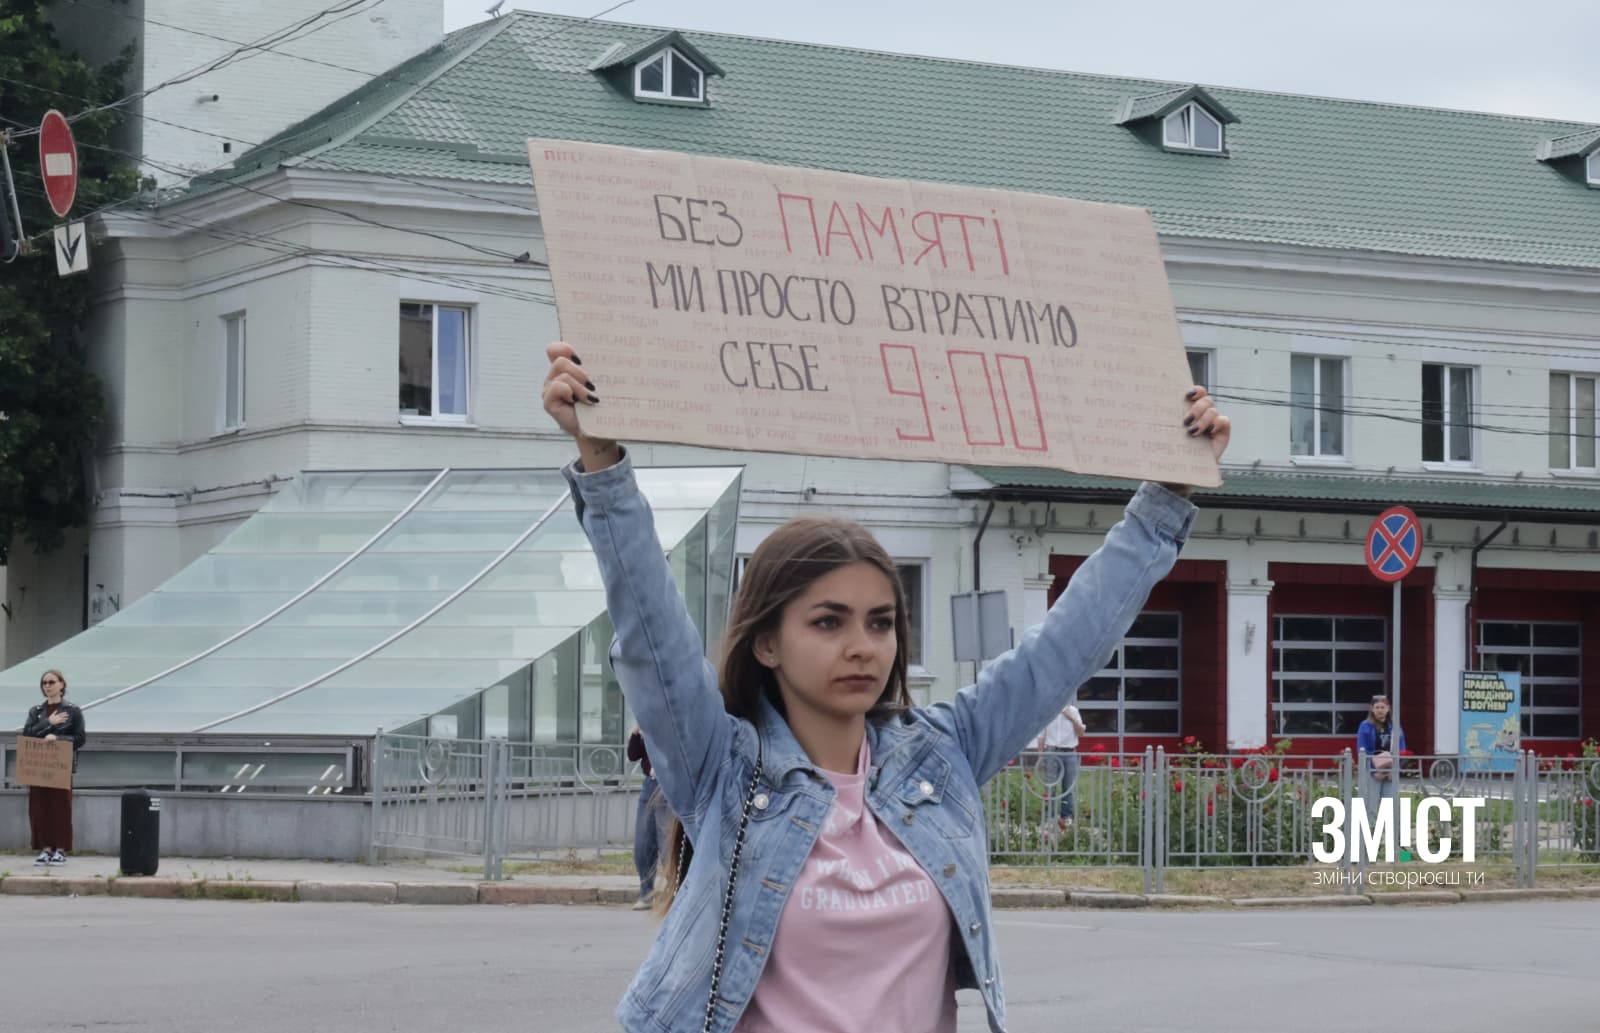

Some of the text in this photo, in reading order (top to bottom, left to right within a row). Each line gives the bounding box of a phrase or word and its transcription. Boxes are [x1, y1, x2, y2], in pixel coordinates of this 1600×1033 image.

[653, 194, 743, 247] БЕЗ
[646, 262, 705, 313] МИ
[717, 269, 857, 326] ПРОСТО
[881, 284, 1077, 348] ВТРАТИМО
[719, 341, 1049, 452] СЕБЕ 9:00
[1464, 680, 1505, 690] ПРАВИЛА
[801, 880, 931, 912] GRADUATED
